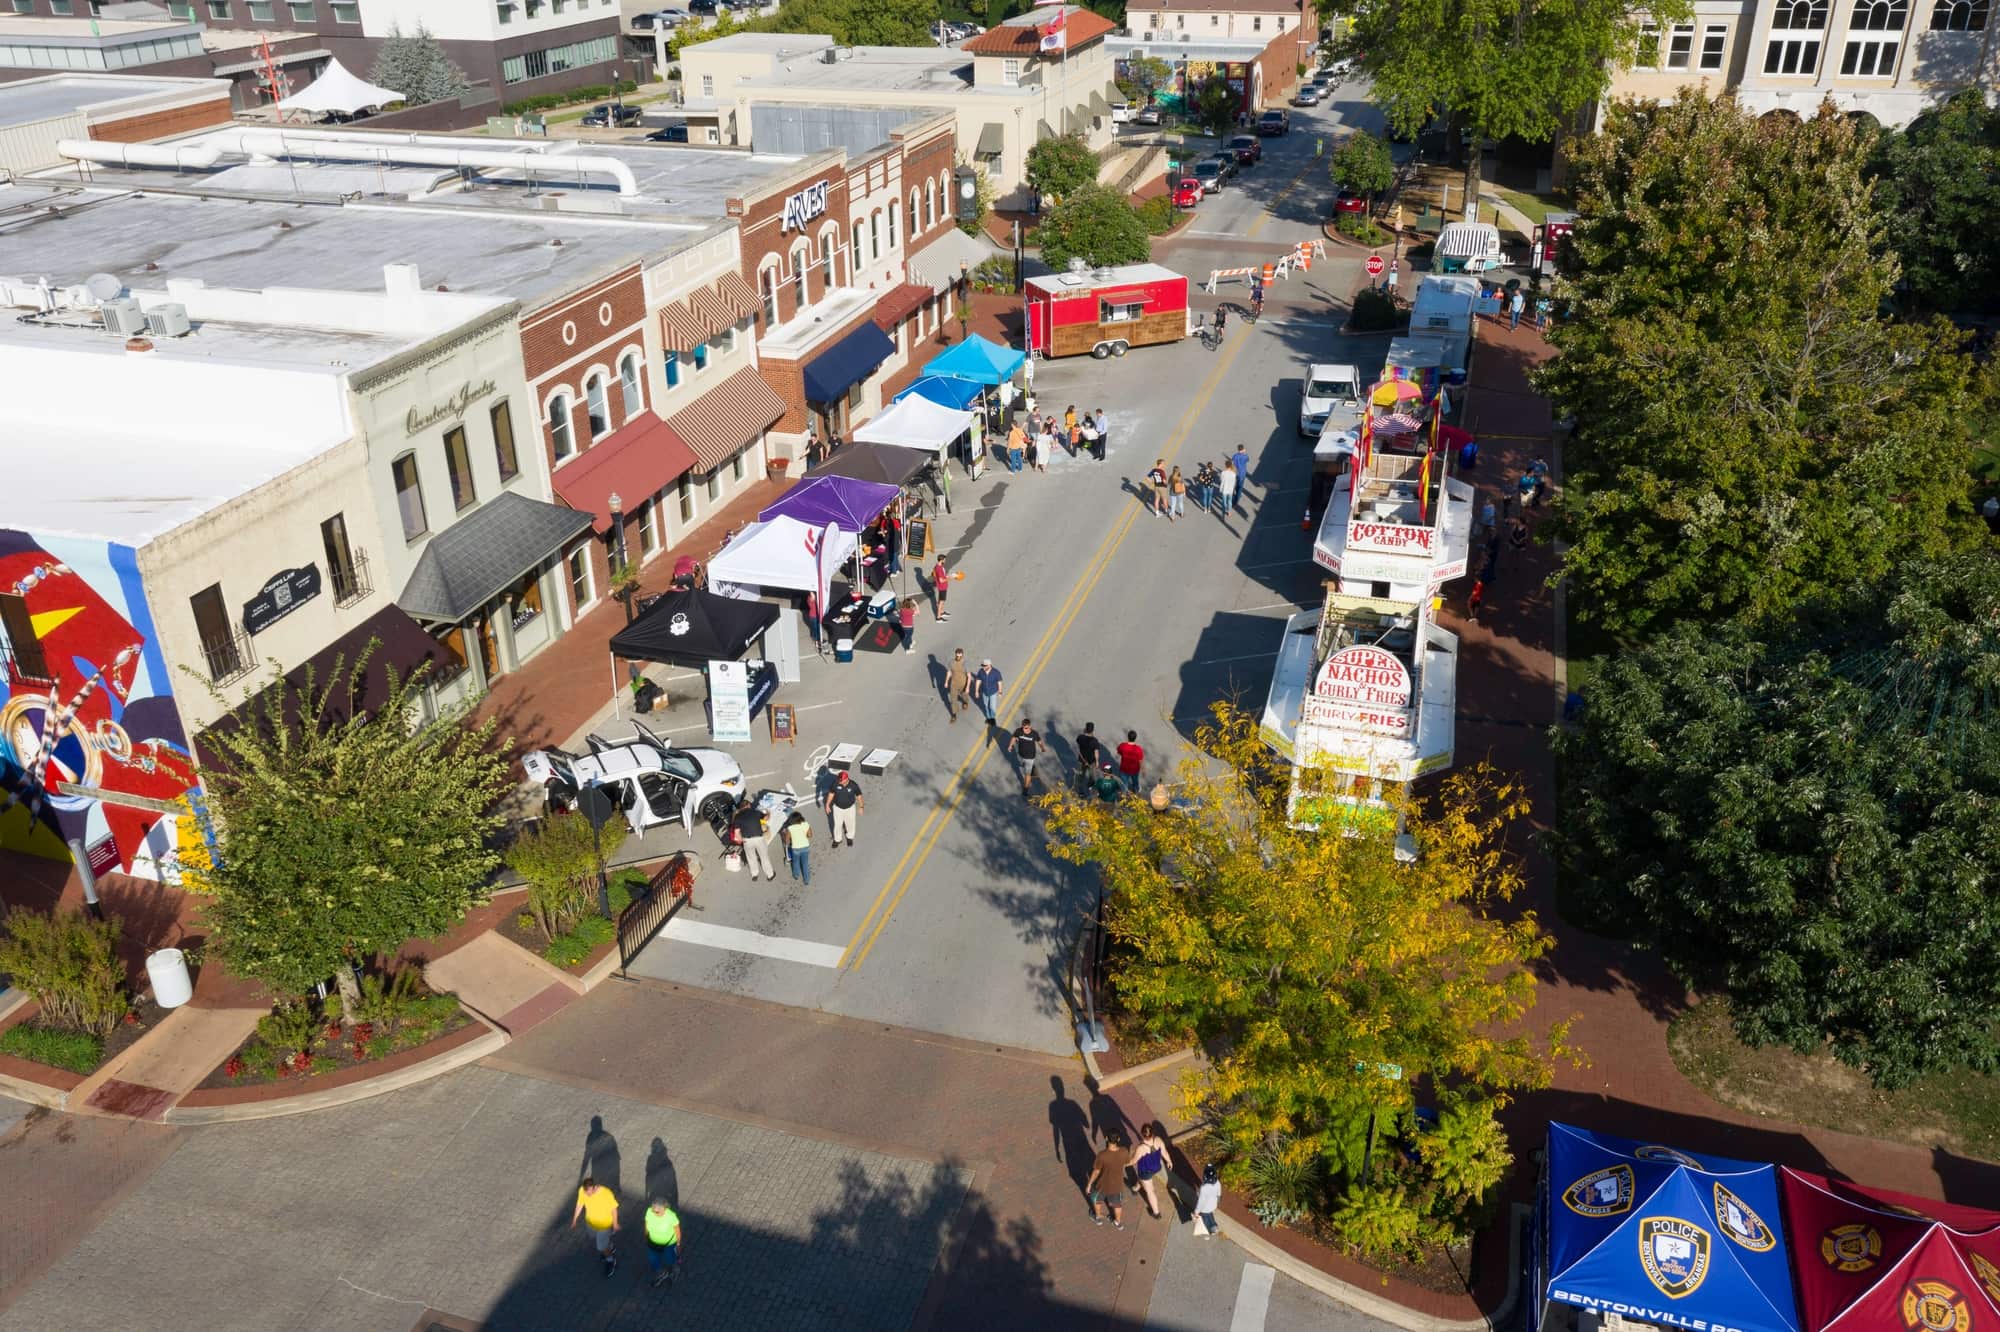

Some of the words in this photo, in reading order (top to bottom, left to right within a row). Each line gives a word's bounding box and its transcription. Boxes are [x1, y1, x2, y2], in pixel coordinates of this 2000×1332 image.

[781, 179, 829, 232] ARVEST
[1366, 261, 1383, 270] STOP
[1352, 523, 1433, 549] COTTON
[1374, 536, 1408, 547] CANDY
[1337, 650, 1400, 670] SUPER
[1328, 664, 1403, 687] NACHOS
[1318, 681, 1360, 699] CURLY
[1367, 687, 1407, 706] FRIES
[1312, 706, 1357, 720] CURLY
[1359, 713, 1406, 728] FRIES
[1619, 1170, 1632, 1203] POLICE
[1652, 1221, 1700, 1241] POLICE
[1643, 1241, 1666, 1286] BENTONVILLE
[1685, 1253, 1706, 1289] ARKANSAS
[1553, 1290, 1707, 1331] BENTONVILLE
